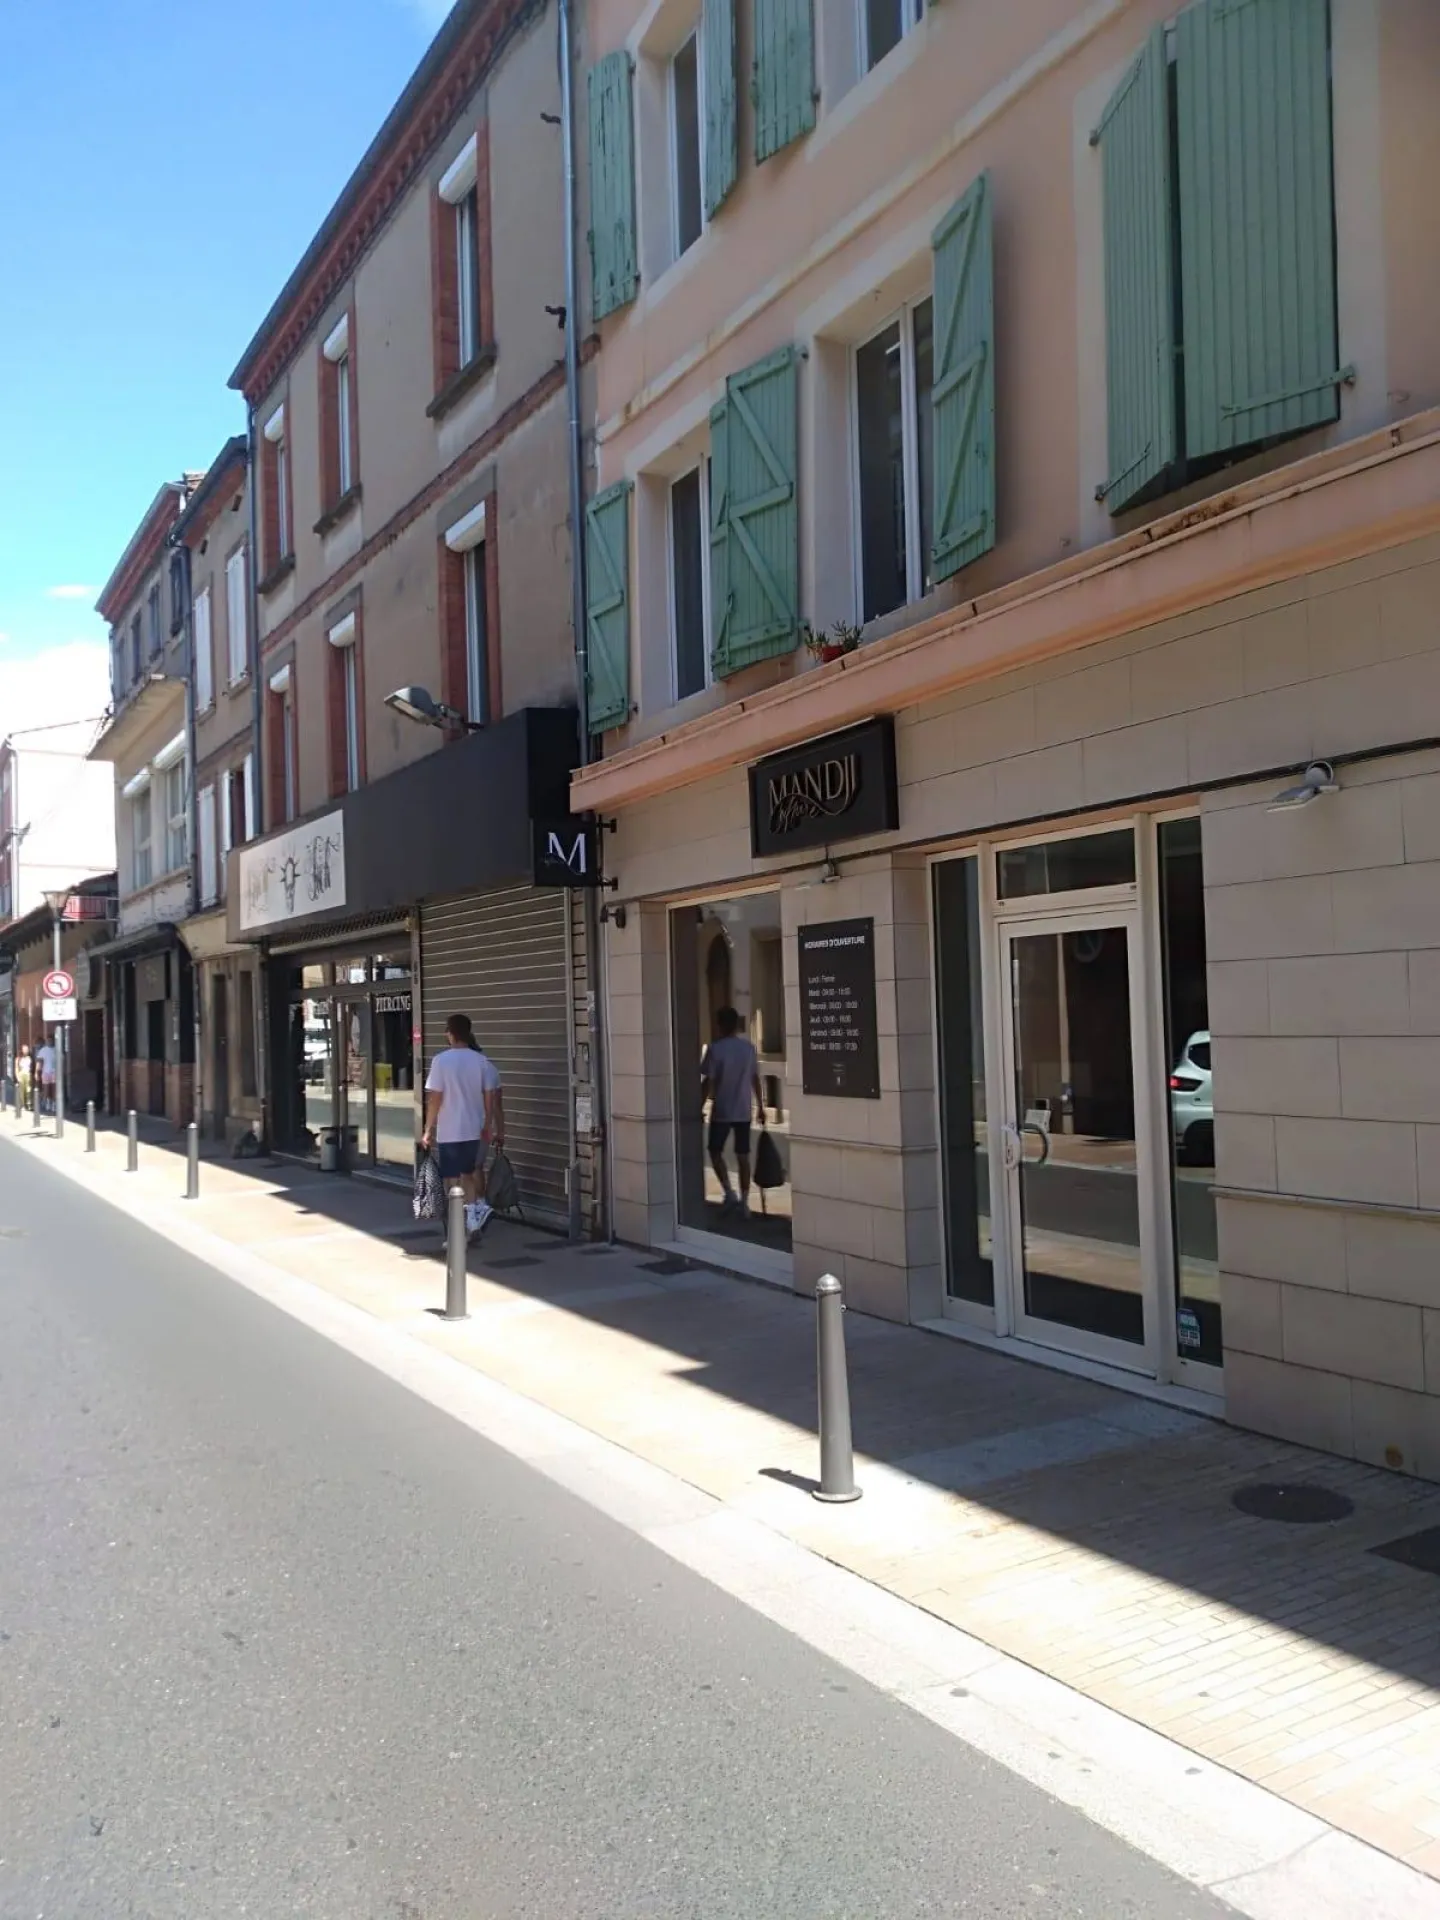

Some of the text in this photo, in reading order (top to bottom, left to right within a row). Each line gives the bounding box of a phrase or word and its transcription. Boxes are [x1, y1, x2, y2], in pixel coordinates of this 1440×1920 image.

[768, 753, 856, 816] MANDJI
[548, 832, 586, 873] M
[375, 995, 411, 1014] PIERCING
